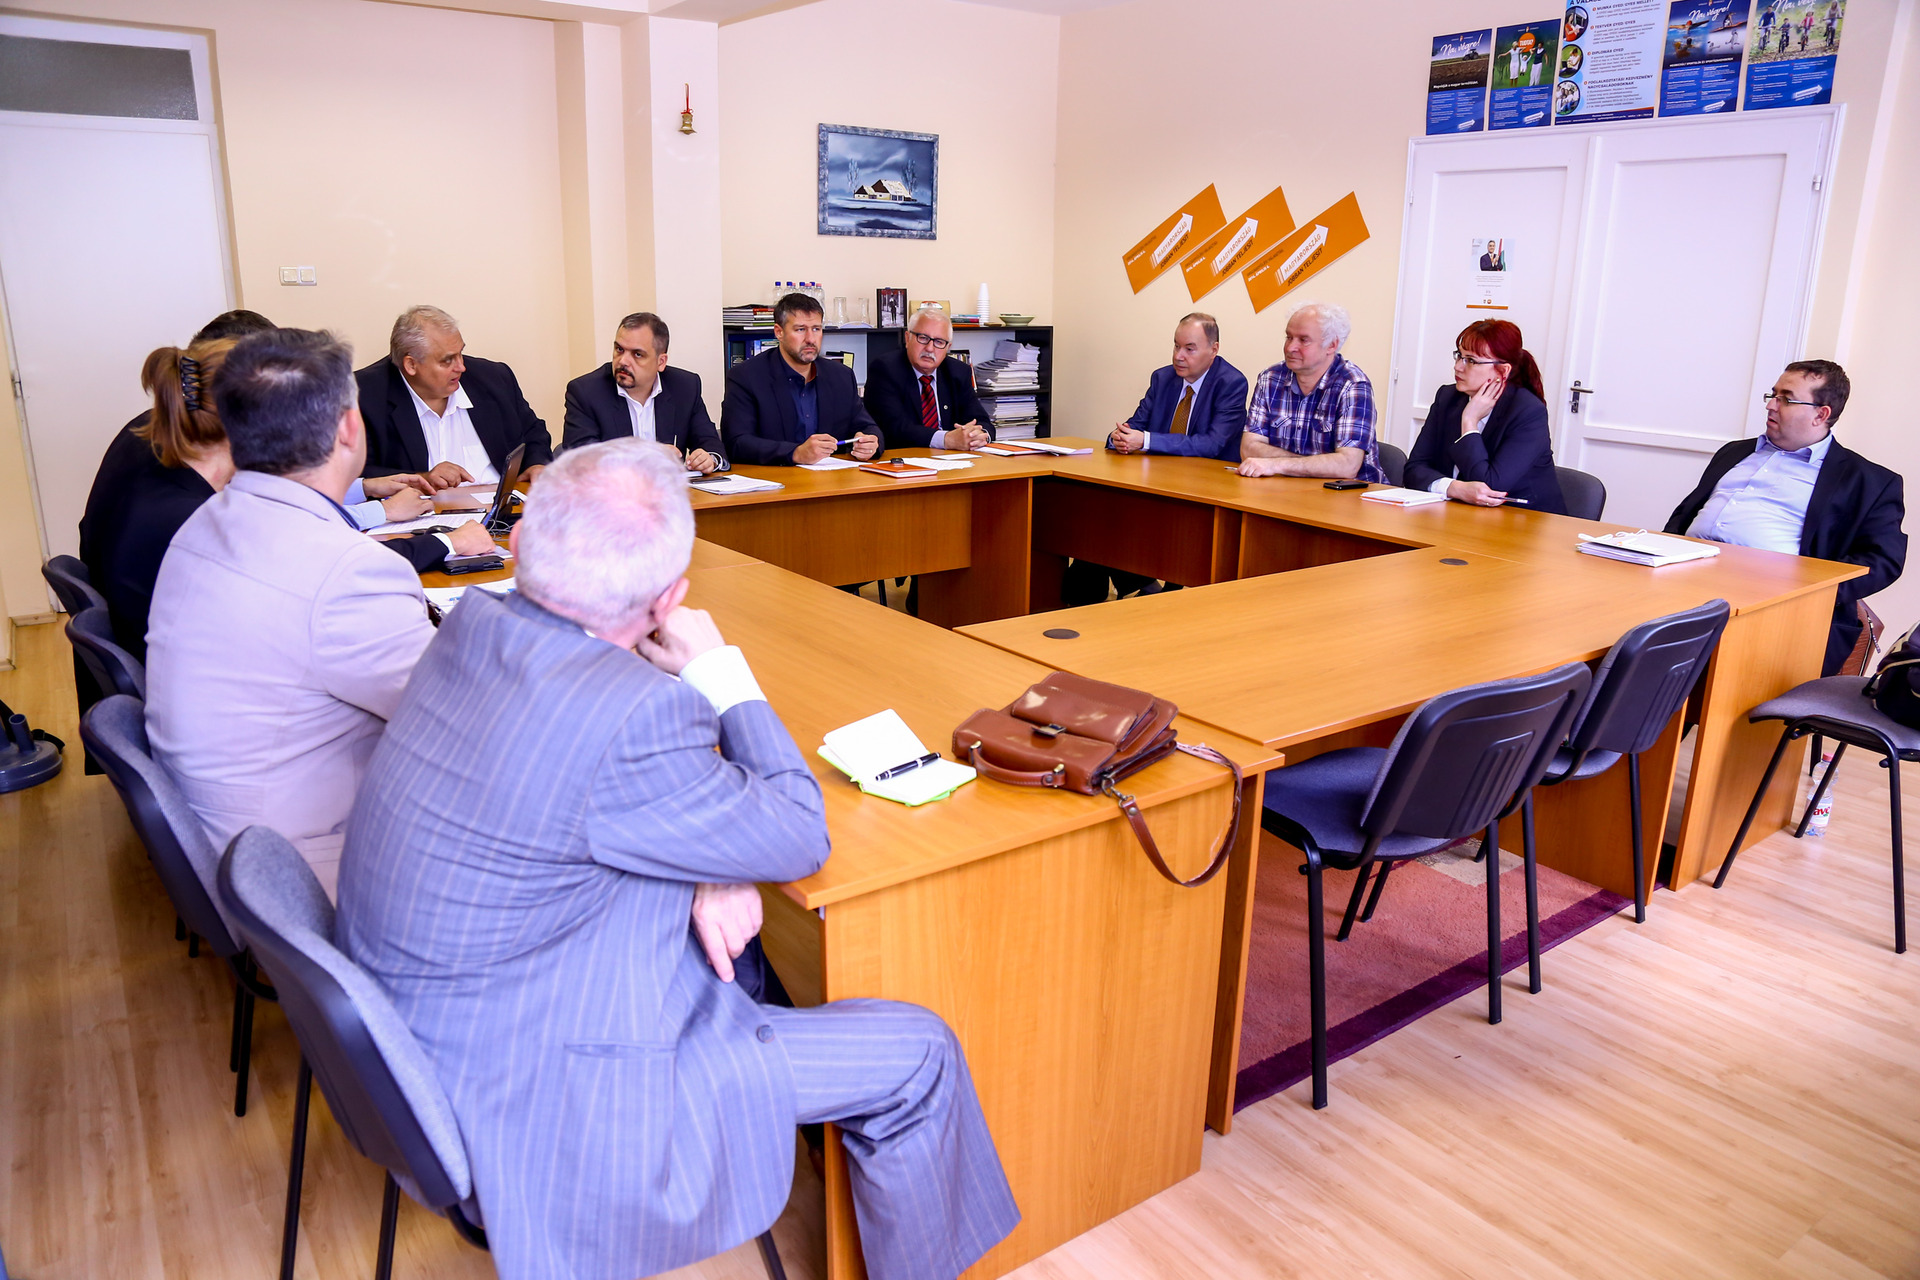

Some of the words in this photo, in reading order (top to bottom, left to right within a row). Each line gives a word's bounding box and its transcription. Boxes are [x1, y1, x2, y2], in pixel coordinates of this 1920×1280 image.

[1157, 221, 1188, 257] MAGYARORSZÁG
[1218, 226, 1252, 264] MAGYARORSZÁG
[1283, 233, 1322, 274] MAGYARORSZÁG
[1287, 267, 1304, 287] JOBBAN
